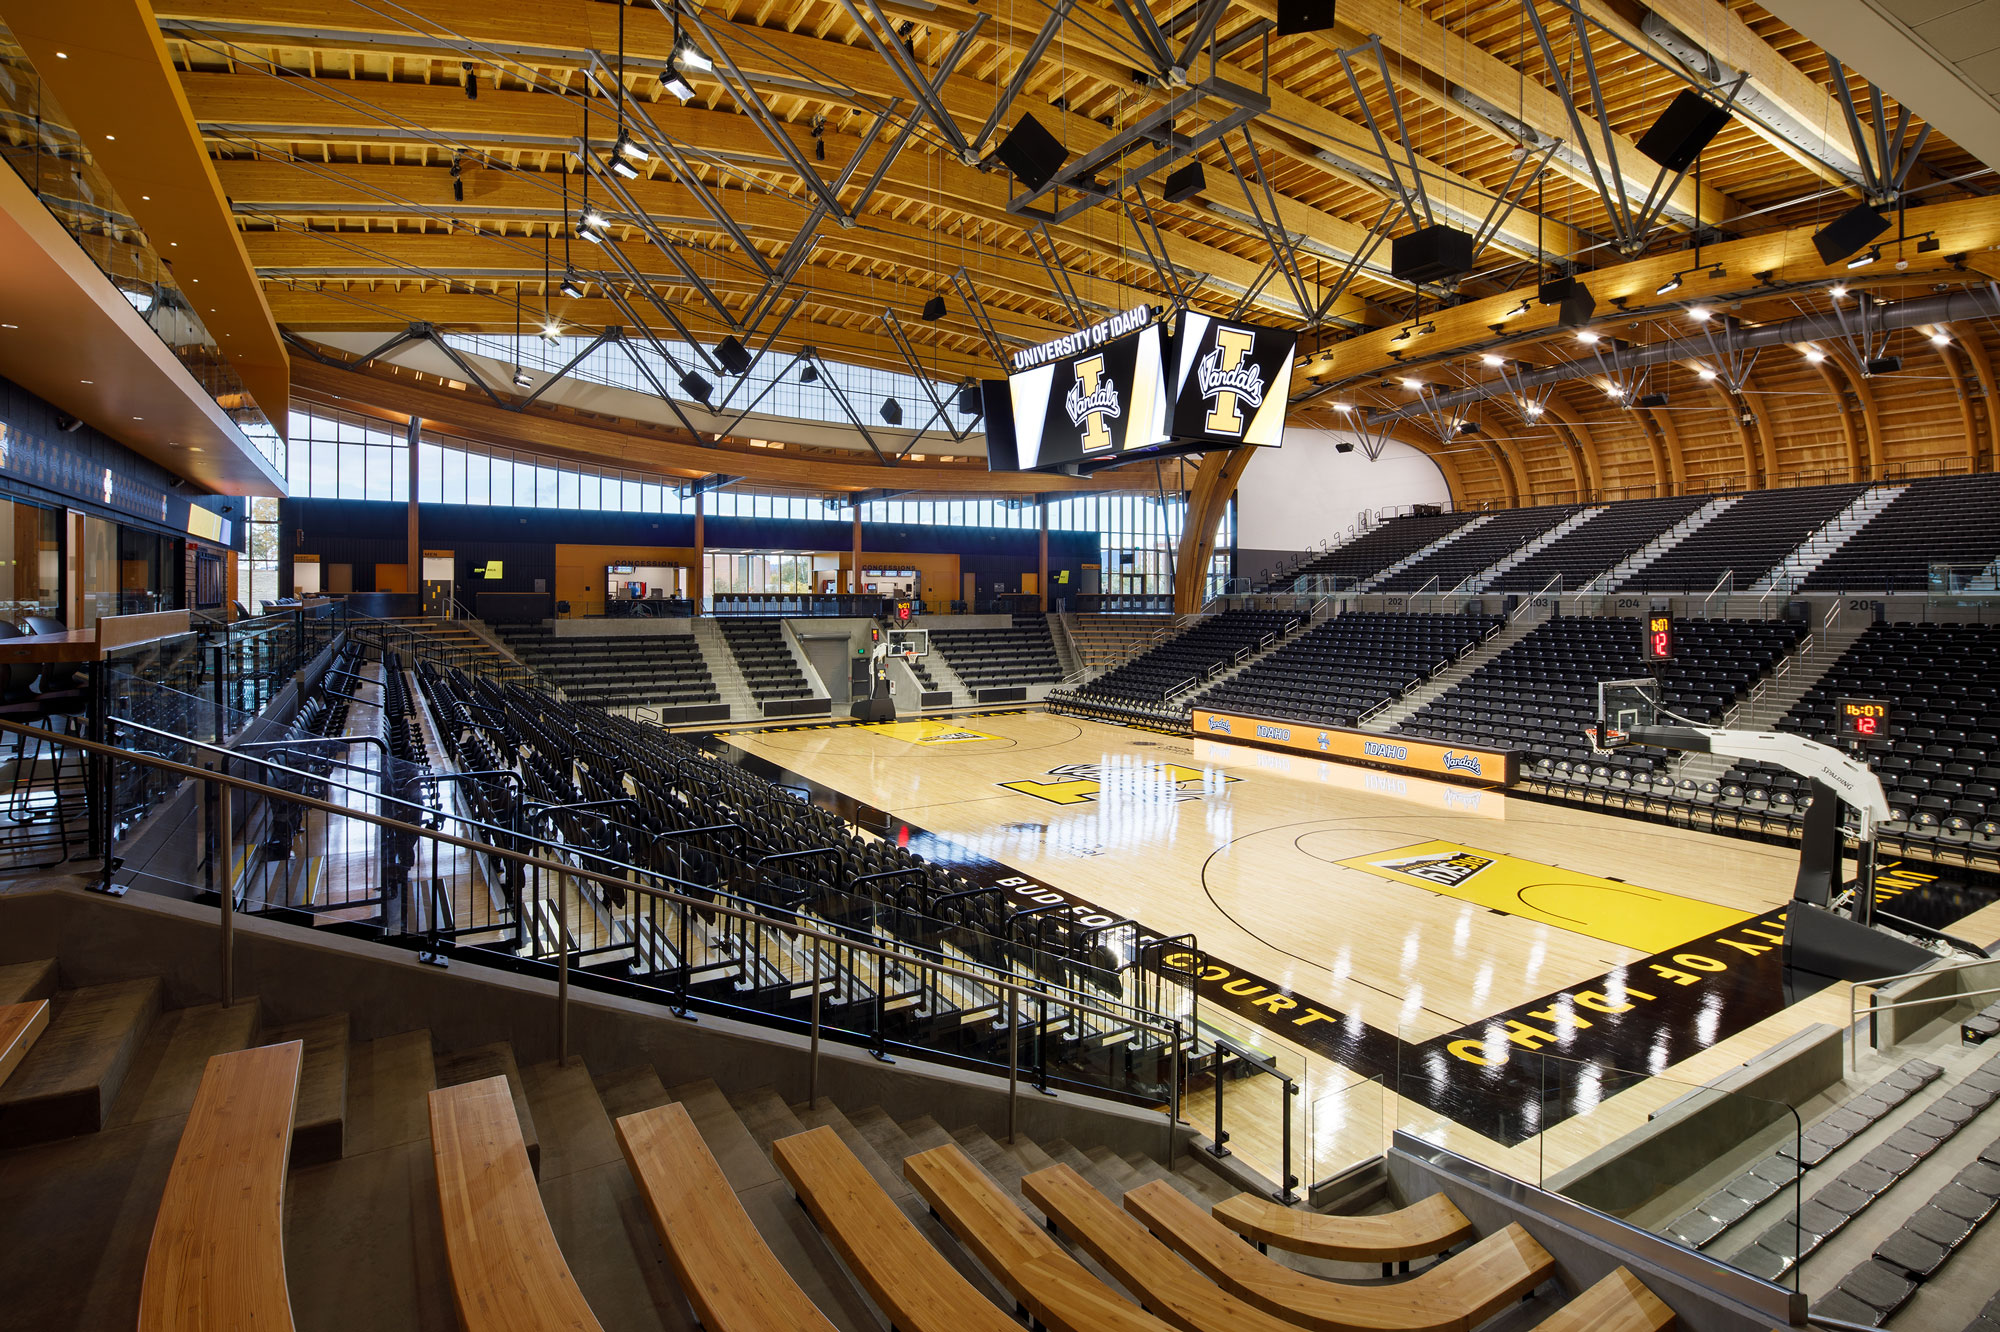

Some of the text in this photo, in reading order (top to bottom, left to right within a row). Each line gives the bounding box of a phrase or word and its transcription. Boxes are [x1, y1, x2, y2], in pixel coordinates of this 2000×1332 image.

[1013, 304, 1149, 369] UNIVERSITY OF IDAHO
[1197, 348, 1263, 408] Vandals
[1065, 378, 1121, 428] Vandals
[1388, 597, 1403, 606] 202
[1618, 598, 1640, 608] 204
[1655, 632, 1667, 656] 12
[1846, 704, 1884, 717] 16:07
[1208, 715, 1232, 734] Vandals
[1256, 724, 1291, 742] IDAHO
[1857, 717, 1876, 734] 12
[1364, 741, 1408, 760] IDAHO
[1443, 750, 1482, 776] Vandals
[1821, 766, 1855, 790] SPALDING
[995, 876, 1064, 904] BUD
[1163, 952, 1337, 1026] COURT
[1649, 953, 1728, 987] OF
[1447, 982, 1658, 1067] IDAHO
